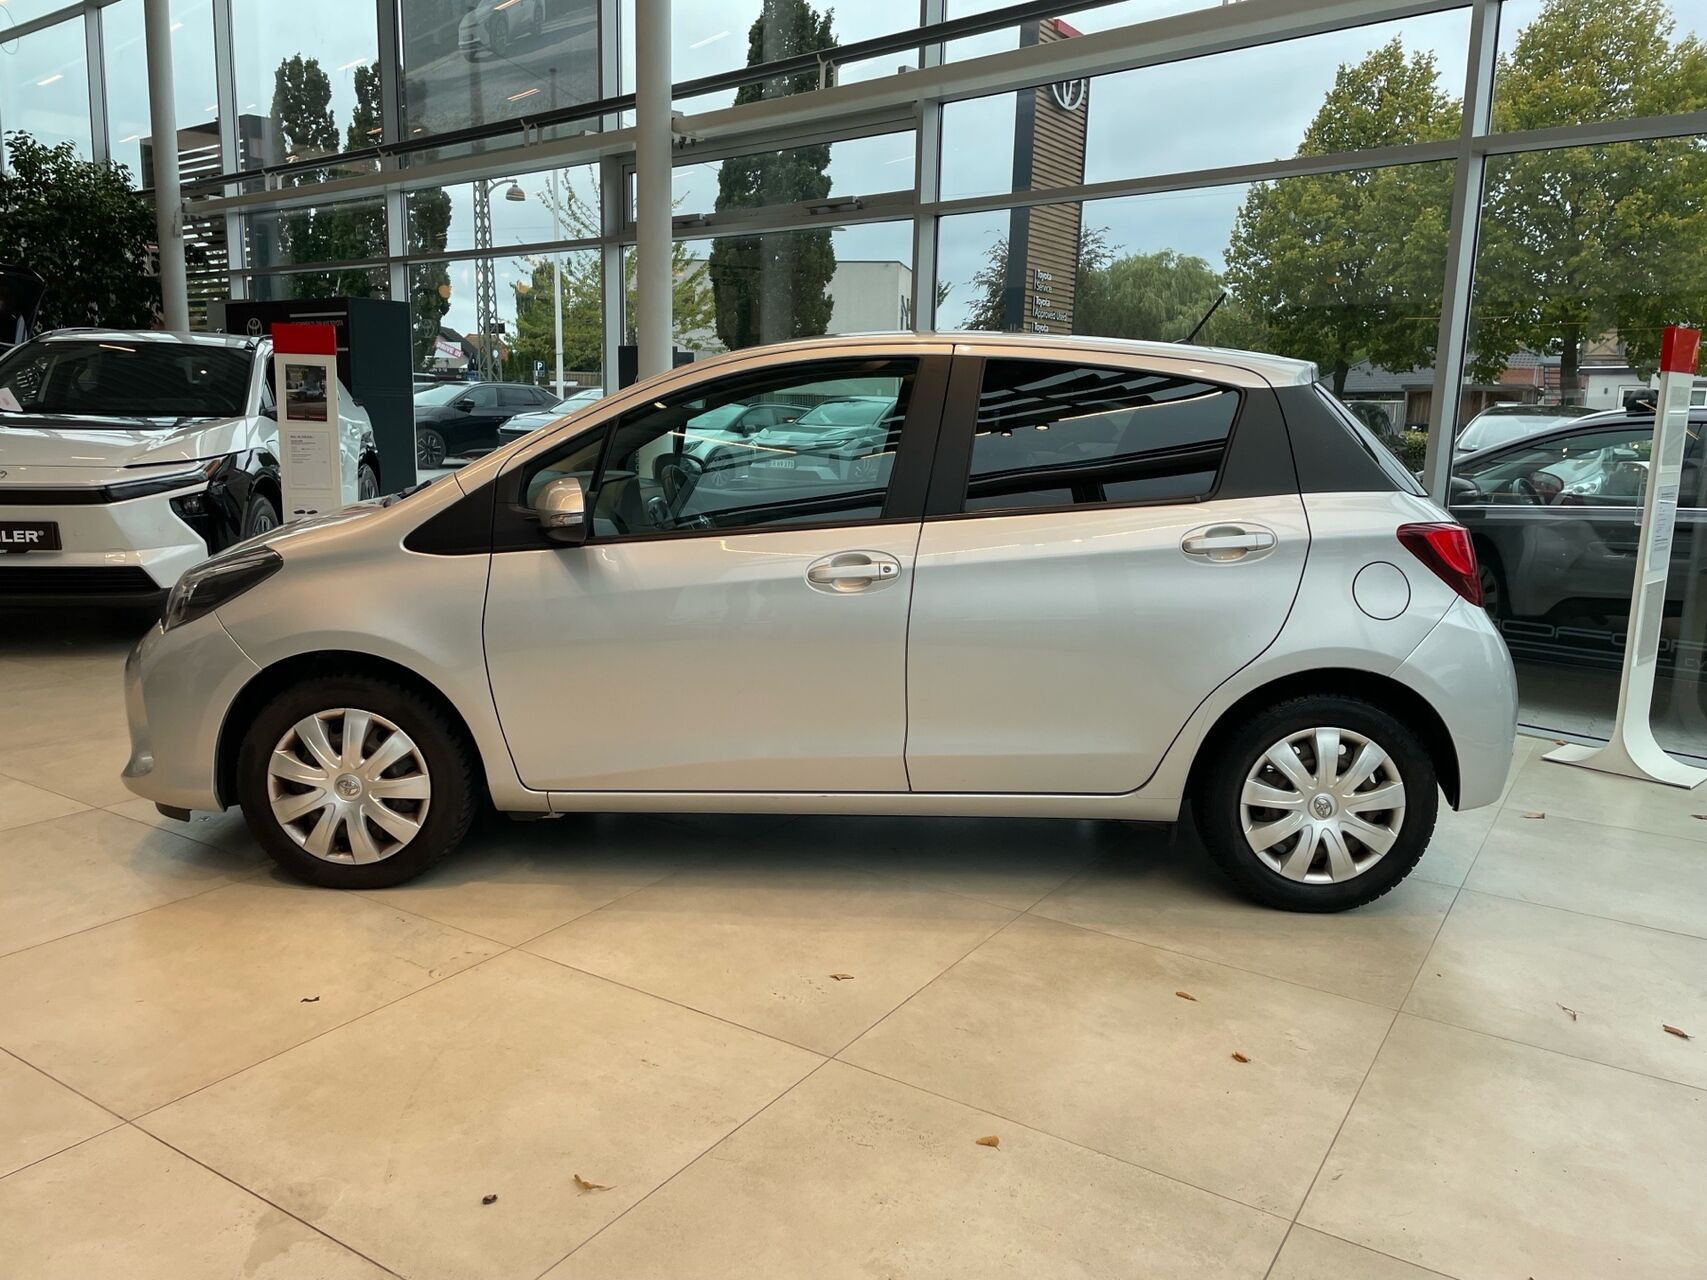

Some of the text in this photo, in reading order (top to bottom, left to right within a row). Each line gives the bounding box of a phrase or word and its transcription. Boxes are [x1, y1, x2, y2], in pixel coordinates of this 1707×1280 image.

[1037, 269, 1052, 281] Toyota
[1036, 281, 1052, 293] Service
[1035, 295, 1051, 308] Toyota
[1034, 321, 1049, 333] Toyota
[537, 361, 543, 371] P
